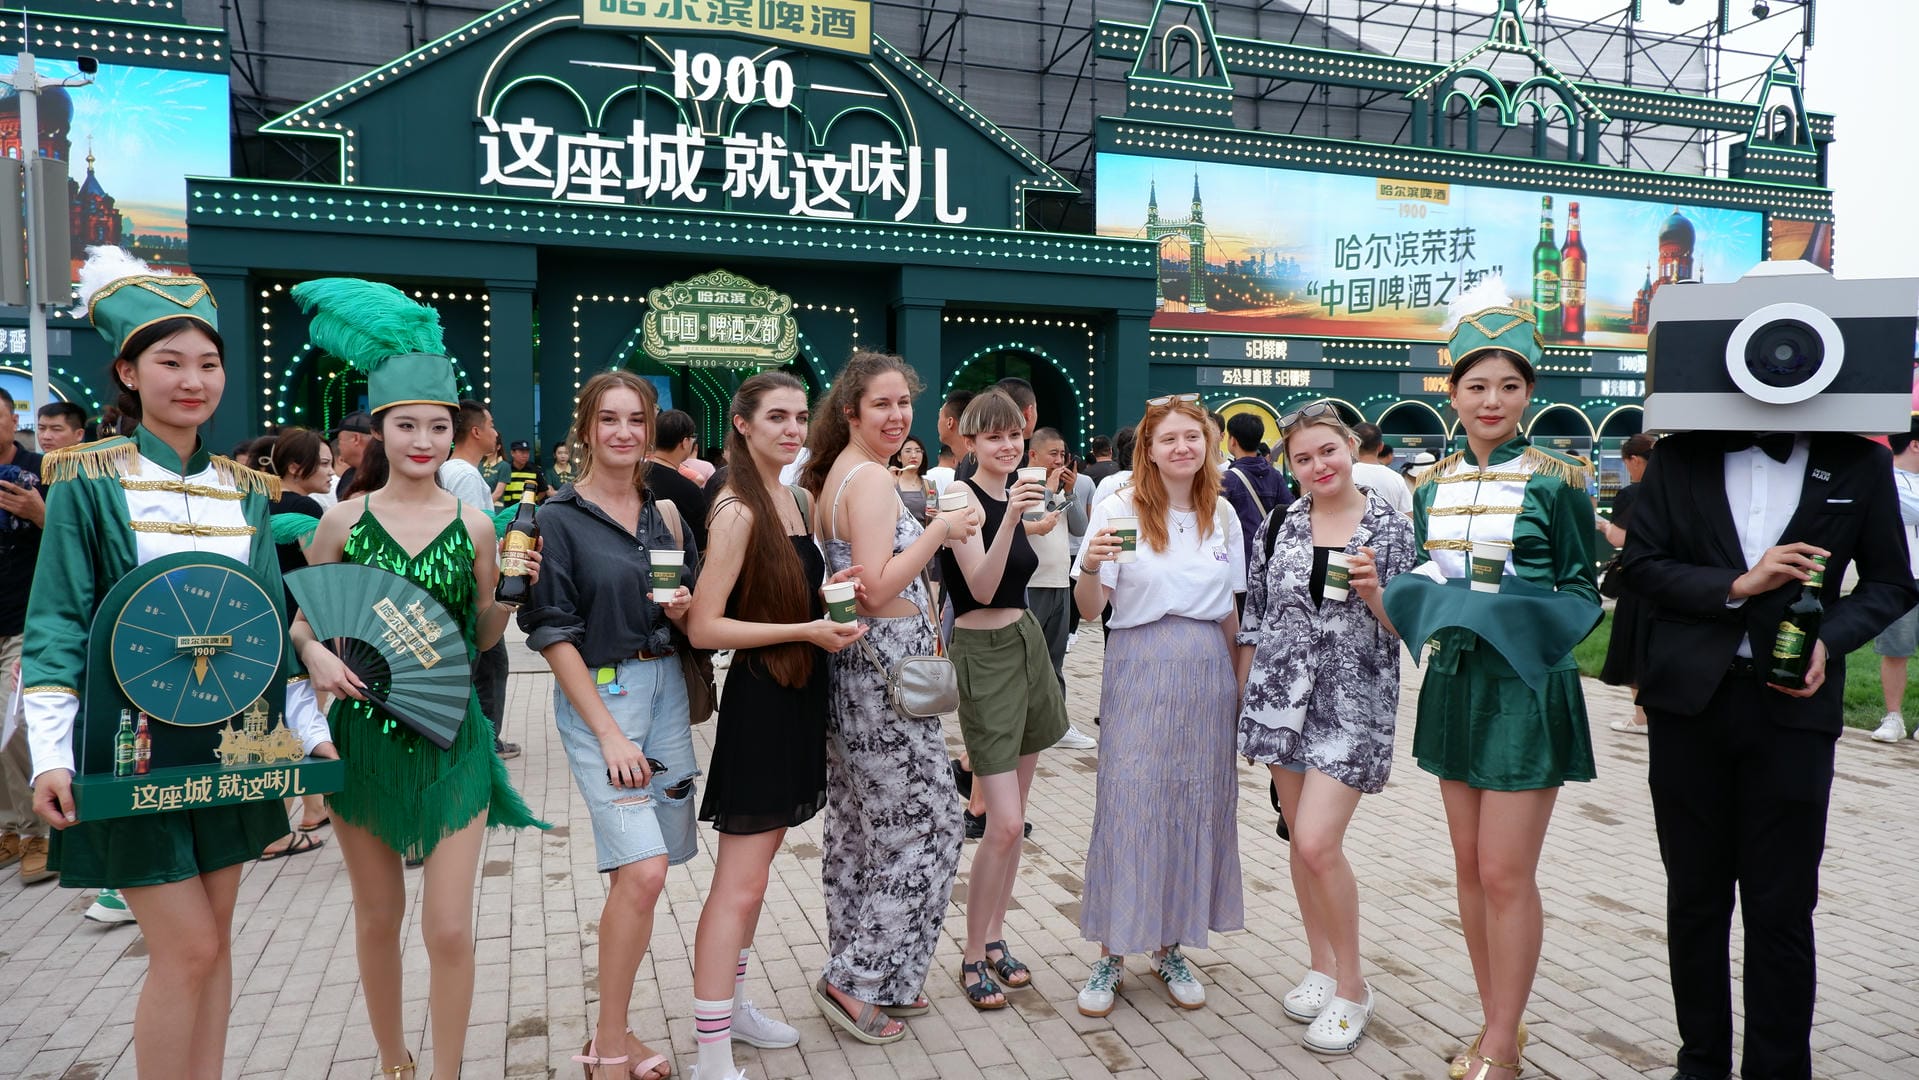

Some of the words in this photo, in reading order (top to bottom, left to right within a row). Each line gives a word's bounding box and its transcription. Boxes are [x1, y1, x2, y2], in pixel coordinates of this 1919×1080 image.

[673, 49, 794, 109] 1900
[480, 116, 707, 204] 这座城
[723, 132, 967, 224] 就这味儿
[1380, 183, 1446, 201] 哈尔滨啤酒
[1399, 203, 1427, 219] 1900
[1335, 226, 1476, 271] 哈尔滨荣获
[697, 290, 746, 304] 哈尔滨
[689, 359, 754, 368] 1900-2024
[193, 647, 216, 656] 1900
[381, 629, 407, 654] 1900
[131, 775, 213, 811] 这座城
[217, 767, 306, 801] 就这味儿
